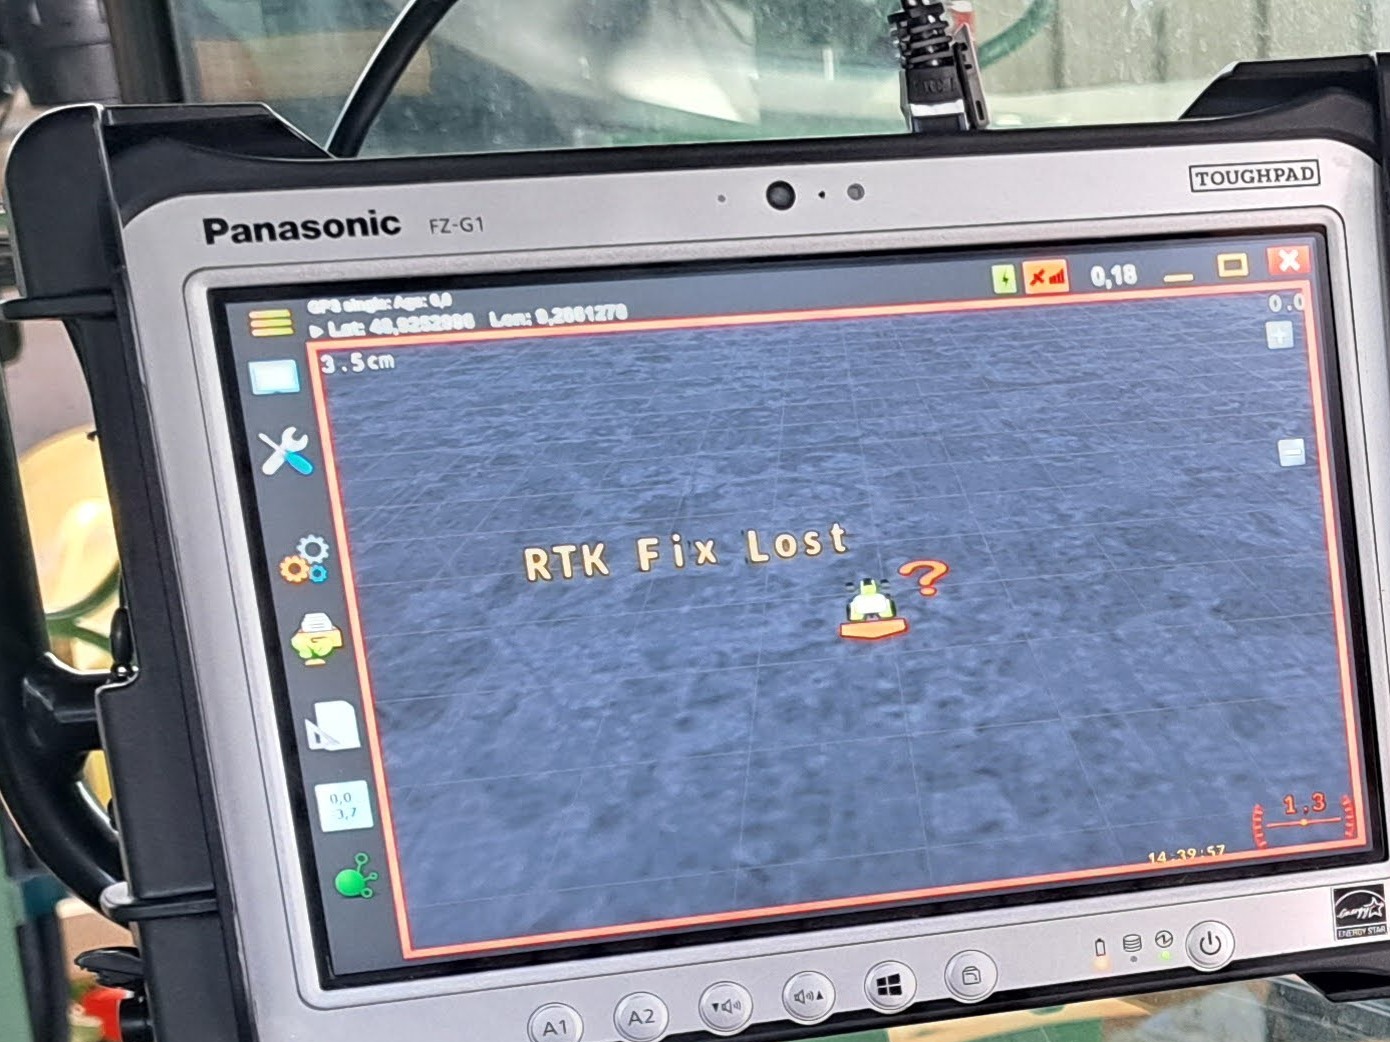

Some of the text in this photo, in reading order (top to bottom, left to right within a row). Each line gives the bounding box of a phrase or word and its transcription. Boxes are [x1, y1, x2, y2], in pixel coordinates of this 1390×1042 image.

[1194, 166, 1315, 186] TOUGHPAD
[202, 209, 484, 245] Panasonic FZ-G1
[1090, 263, 1138, 289] 0,18
[489, 311, 533, 328] Lon:
[522, 522, 848, 582] RTK Fix Lost
[1283, 792, 1327, 815] 1.3
[1148, 844, 1226, 863] 14:39:57
[1338, 925, 1386, 938] ENERGY STAR
[627, 1008, 656, 1026] A2
[542, 1019, 568, 1037] A1
